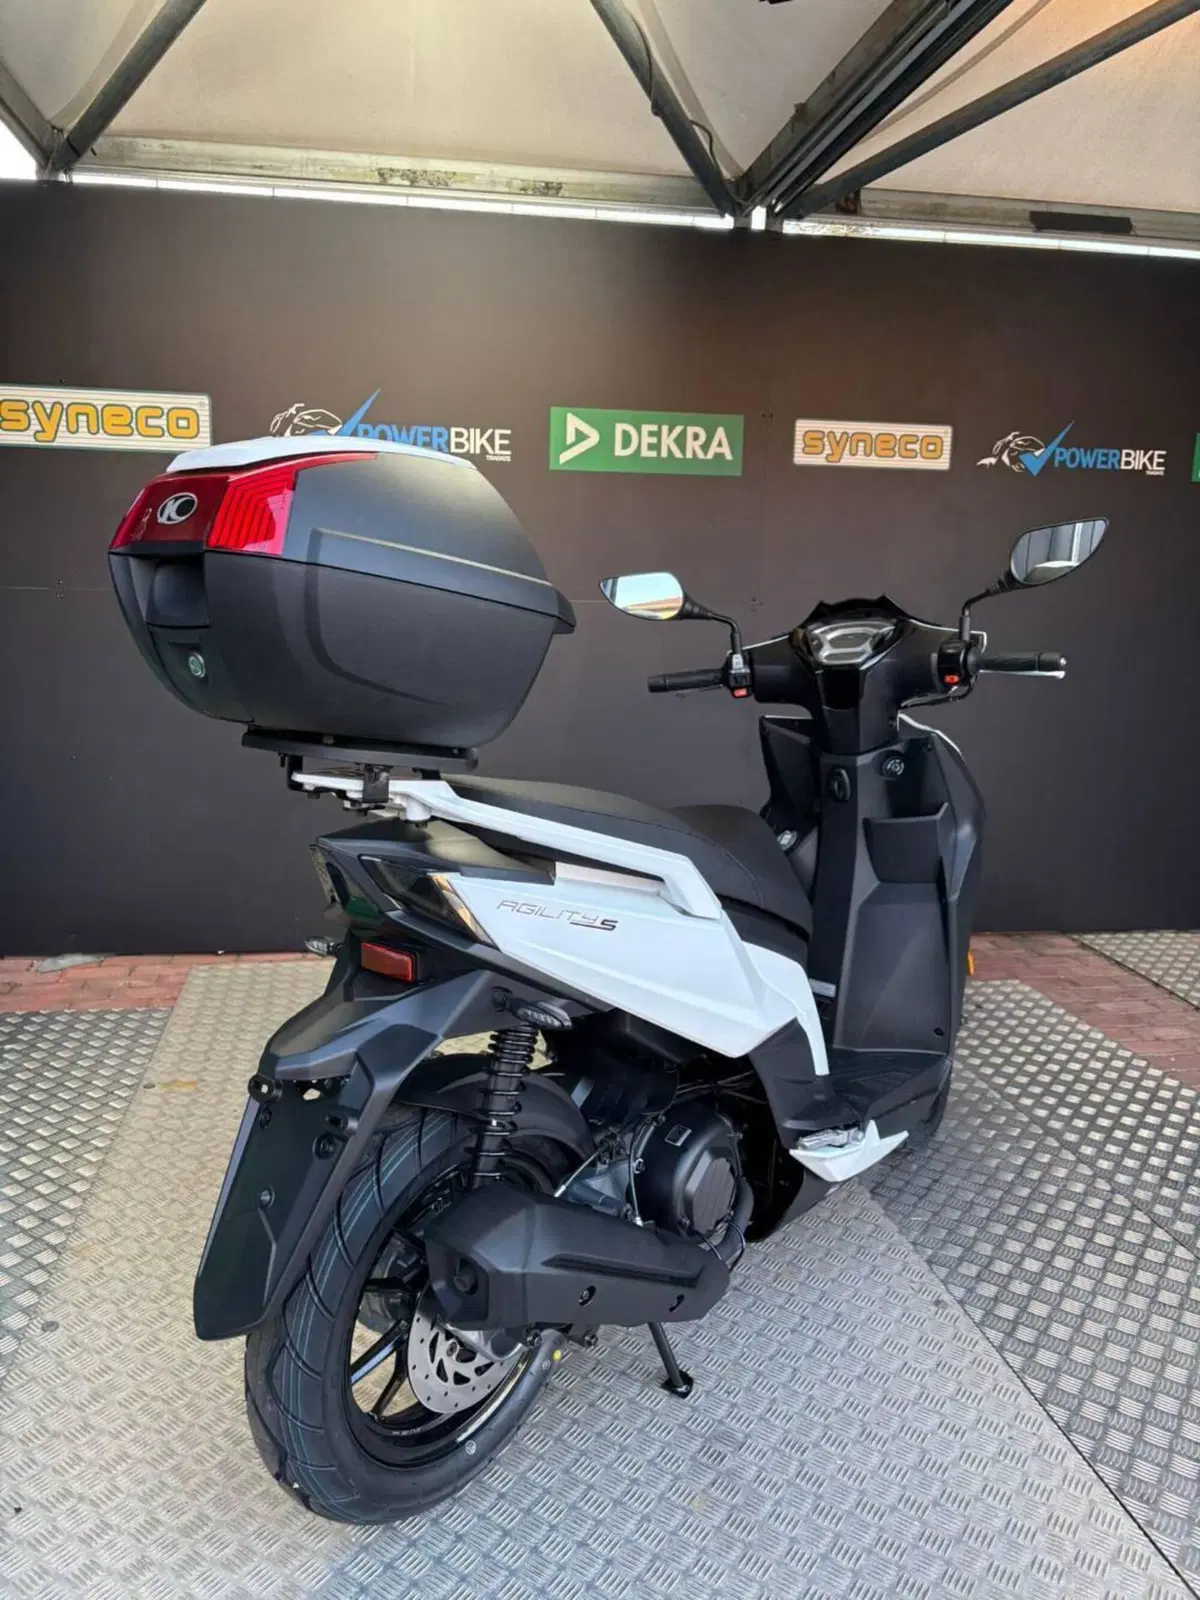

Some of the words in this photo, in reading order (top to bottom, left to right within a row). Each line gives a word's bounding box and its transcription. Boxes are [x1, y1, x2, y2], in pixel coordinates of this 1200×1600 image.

[0, 400, 200, 442] syneco
[614, 423, 733, 460] DEKRA
[802, 430, 944, 463] syneco
[1053, 447, 1167, 471] POWERBIKE
[497, 900, 599, 925] AGILITY
